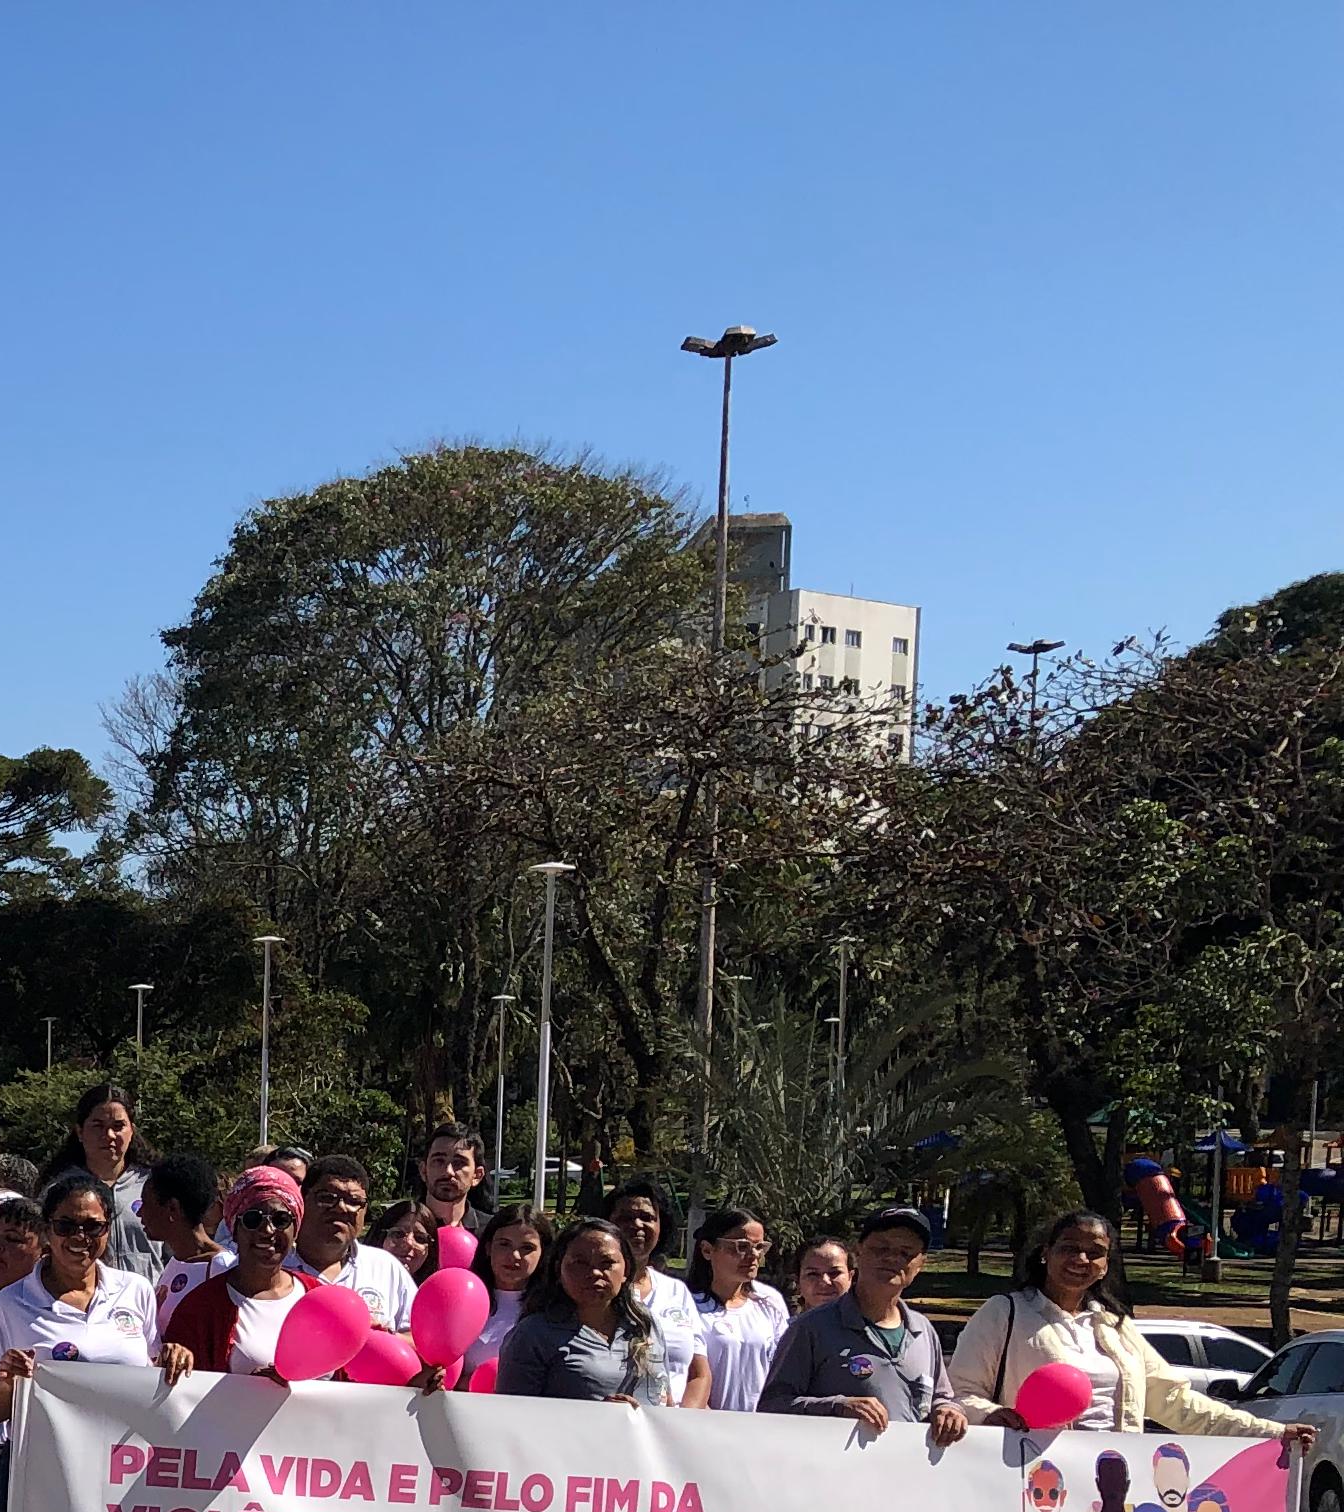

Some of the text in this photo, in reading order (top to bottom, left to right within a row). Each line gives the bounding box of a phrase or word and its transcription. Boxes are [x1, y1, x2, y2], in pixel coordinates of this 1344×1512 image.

[108, 1442, 250, 1493] PELA
[259, 1454, 376, 1501] VIDA
[387, 1463, 419, 1504] E
